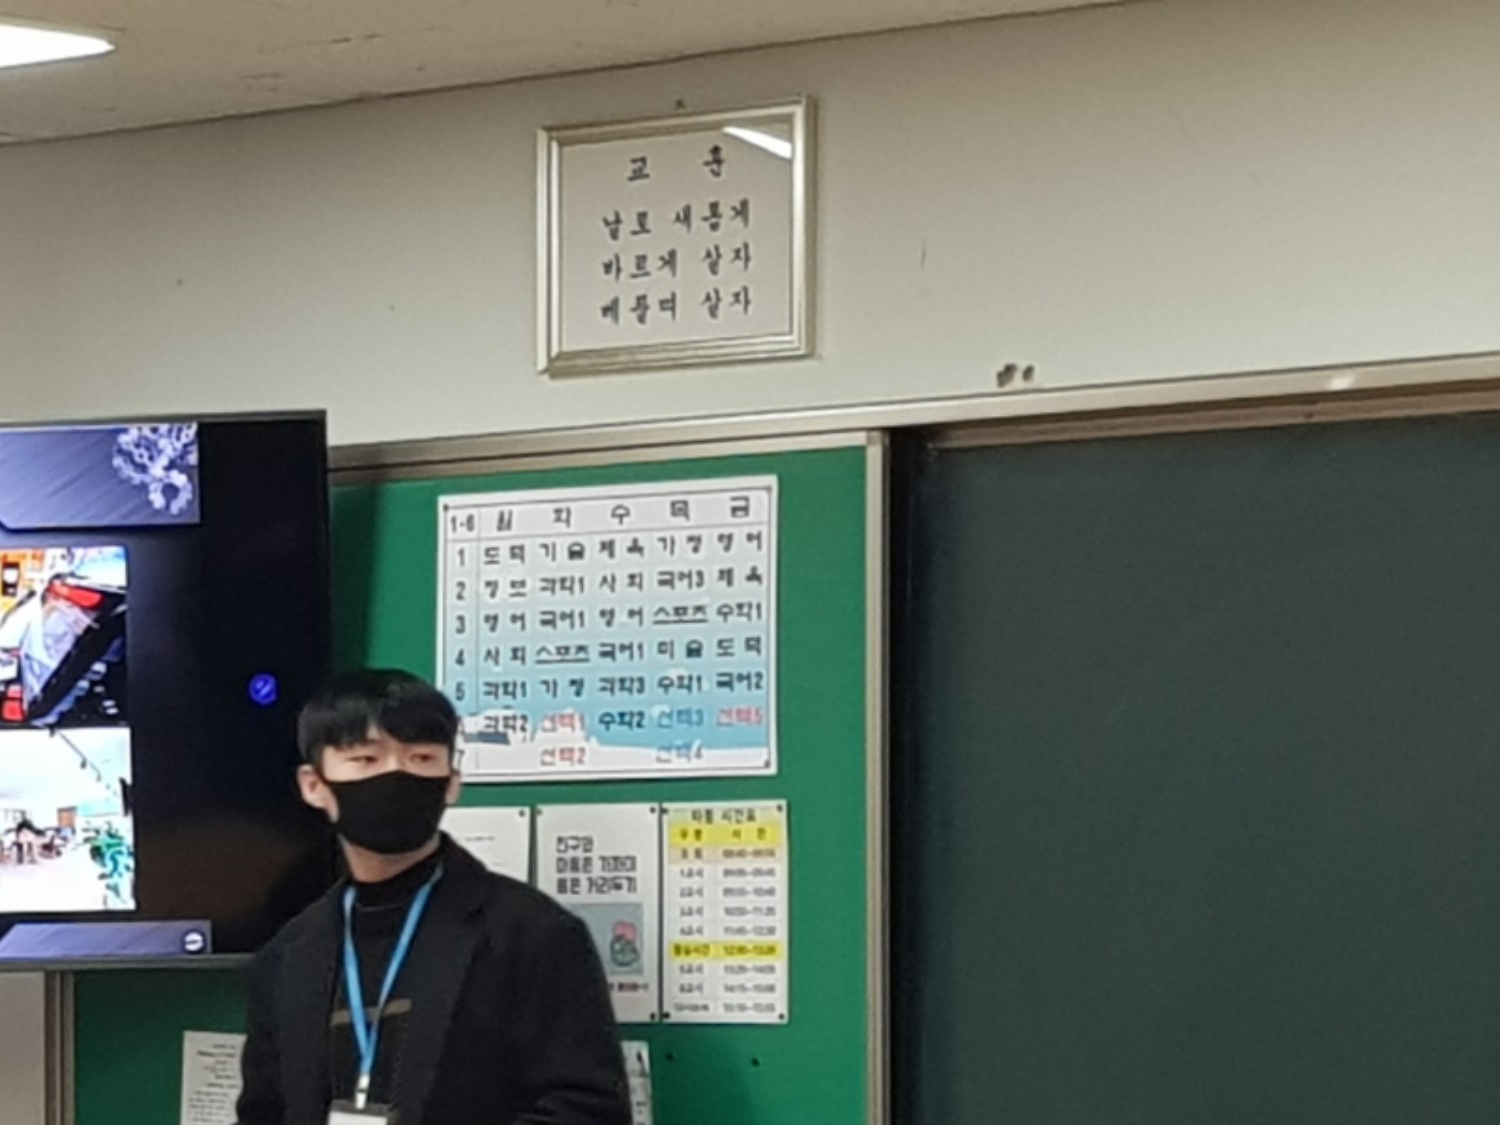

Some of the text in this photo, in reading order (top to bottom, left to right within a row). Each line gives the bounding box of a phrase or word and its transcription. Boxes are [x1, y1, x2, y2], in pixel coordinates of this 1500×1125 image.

[627, 156, 650, 182] 교
[602, 242, 751, 282] 바르게 살자
[701, 286, 751, 319] 살자
[611, 504, 631, 526] 수
[670, 500, 690, 521] 목
[730, 497, 750, 518] 금
[458, 548, 465, 566] 1
[456, 581, 466, 601] 2
[456, 615, 466, 634] 3
[456, 648, 465, 666] 4
[456, 681, 465, 701] 5
